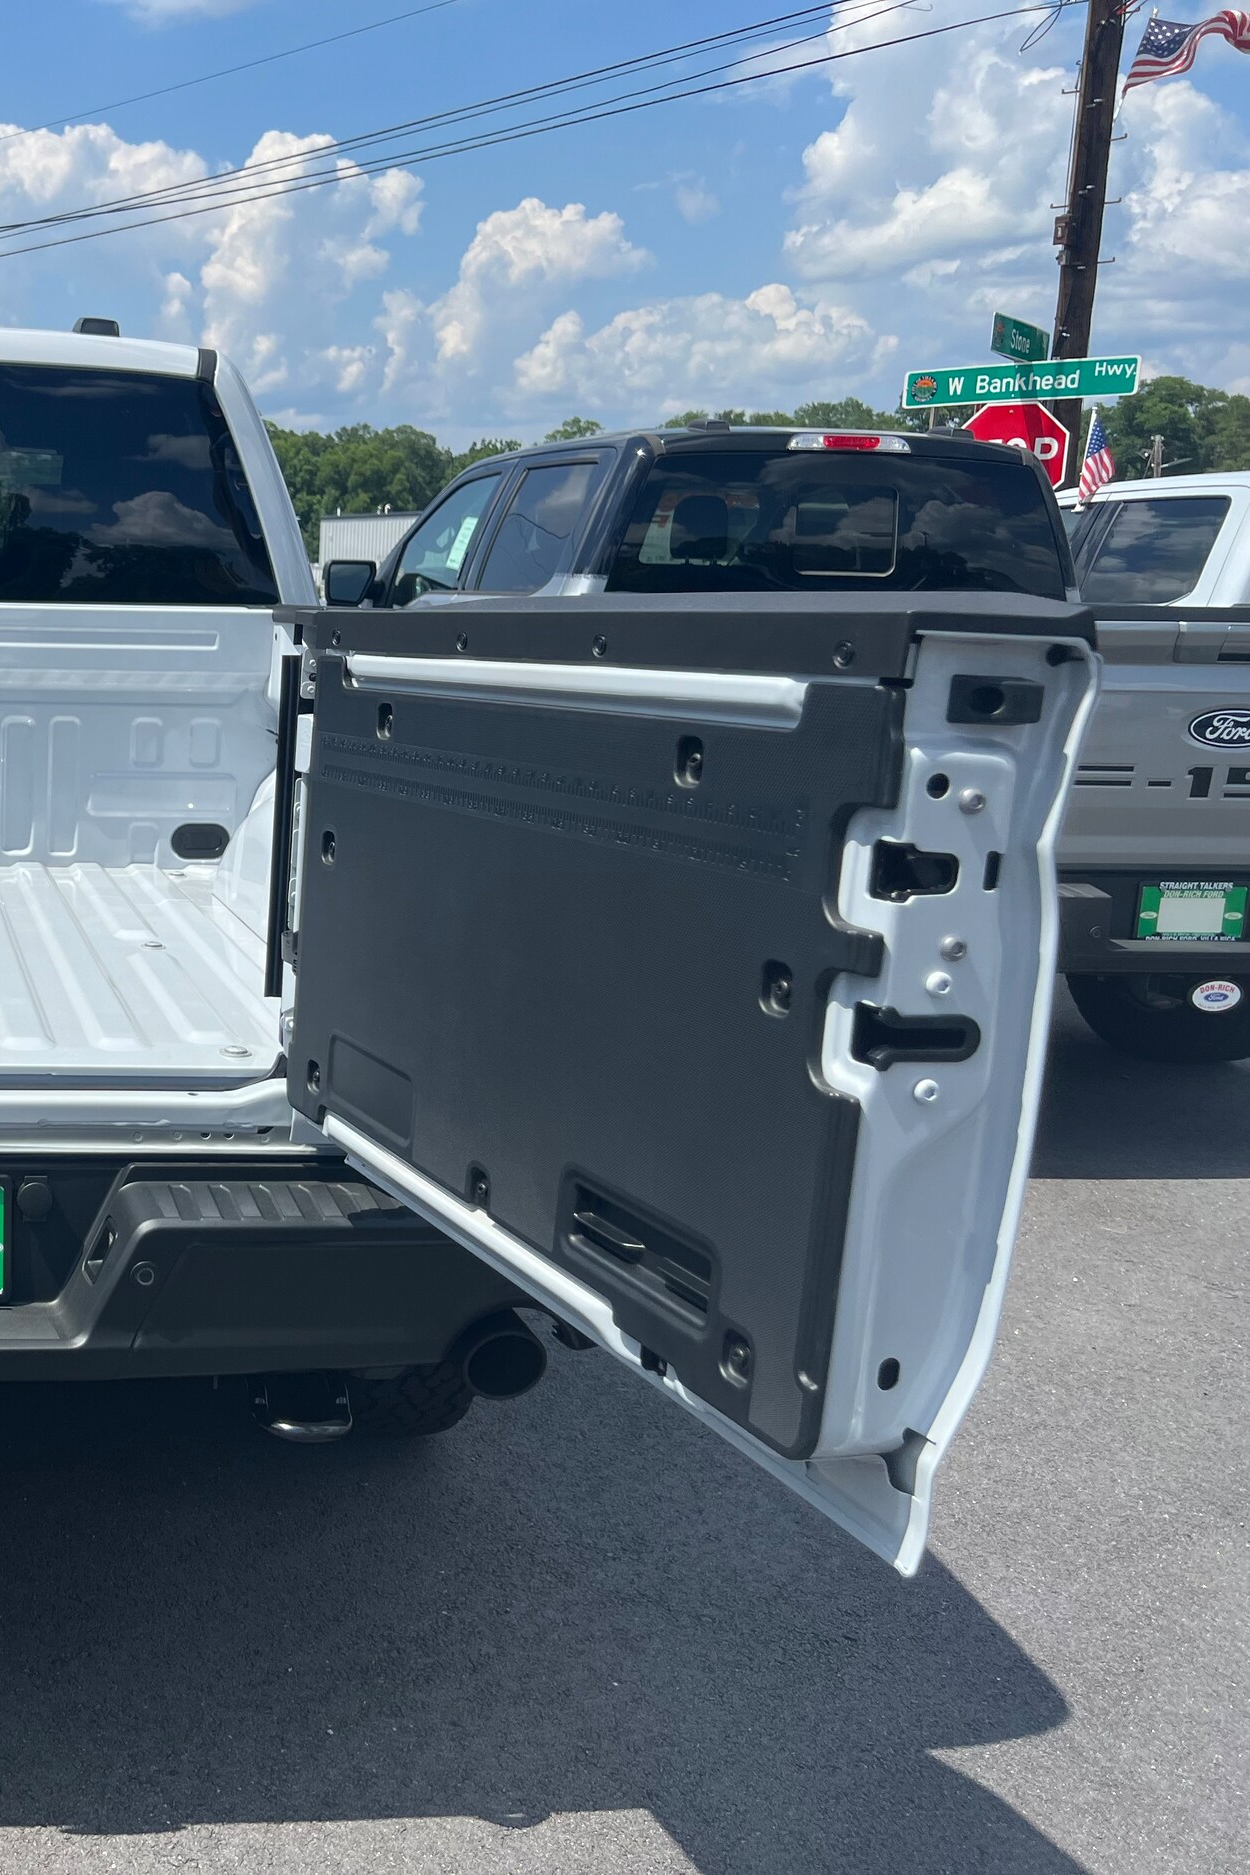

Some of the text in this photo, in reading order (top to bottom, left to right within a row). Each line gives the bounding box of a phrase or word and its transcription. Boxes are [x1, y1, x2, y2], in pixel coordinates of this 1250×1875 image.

[1010, 328, 1031, 354] Stone
[948, 376, 965, 396] W
[975, 369, 1081, 394] Bankhead
[1094, 362, 1137, 378] Hwy.
[1159, 881, 1234, 891] STRAIGHT TALKERS
[1163, 890, 1225, 899] DON-RICH FORD
[1200, 983, 1236, 994] DON-RICH
